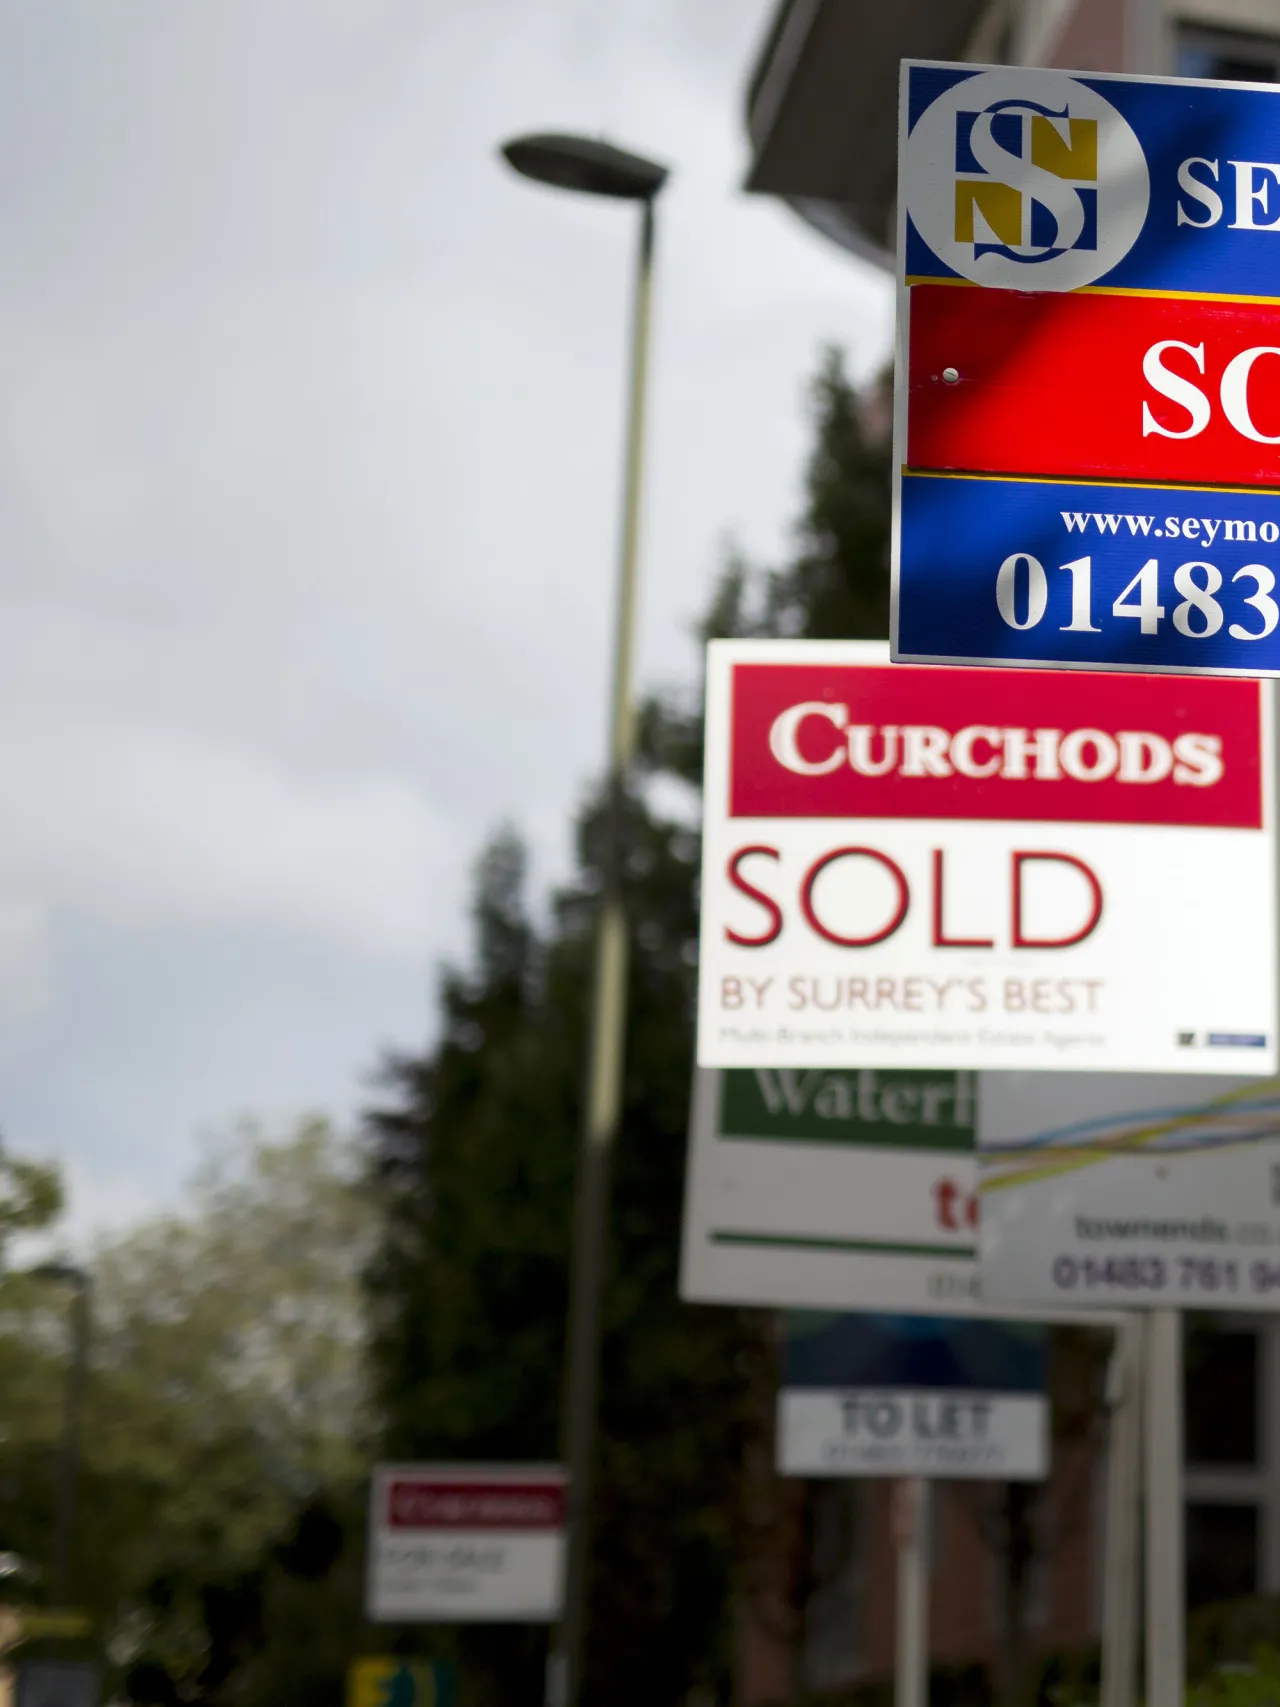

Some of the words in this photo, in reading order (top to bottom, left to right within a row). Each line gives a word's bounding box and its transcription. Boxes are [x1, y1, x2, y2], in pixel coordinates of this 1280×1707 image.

[995, 552, 1280, 641] 01483
[768, 701, 1225, 787] CURCHODS
[723, 844, 1105, 949] SOLD
[719, 975, 775, 1012] BY
[786, 975, 988, 1014] SURREY'S
[1002, 977, 1106, 1015] BEST
[841, 1398, 903, 1440] TO
[913, 1398, 993, 1441] LET
